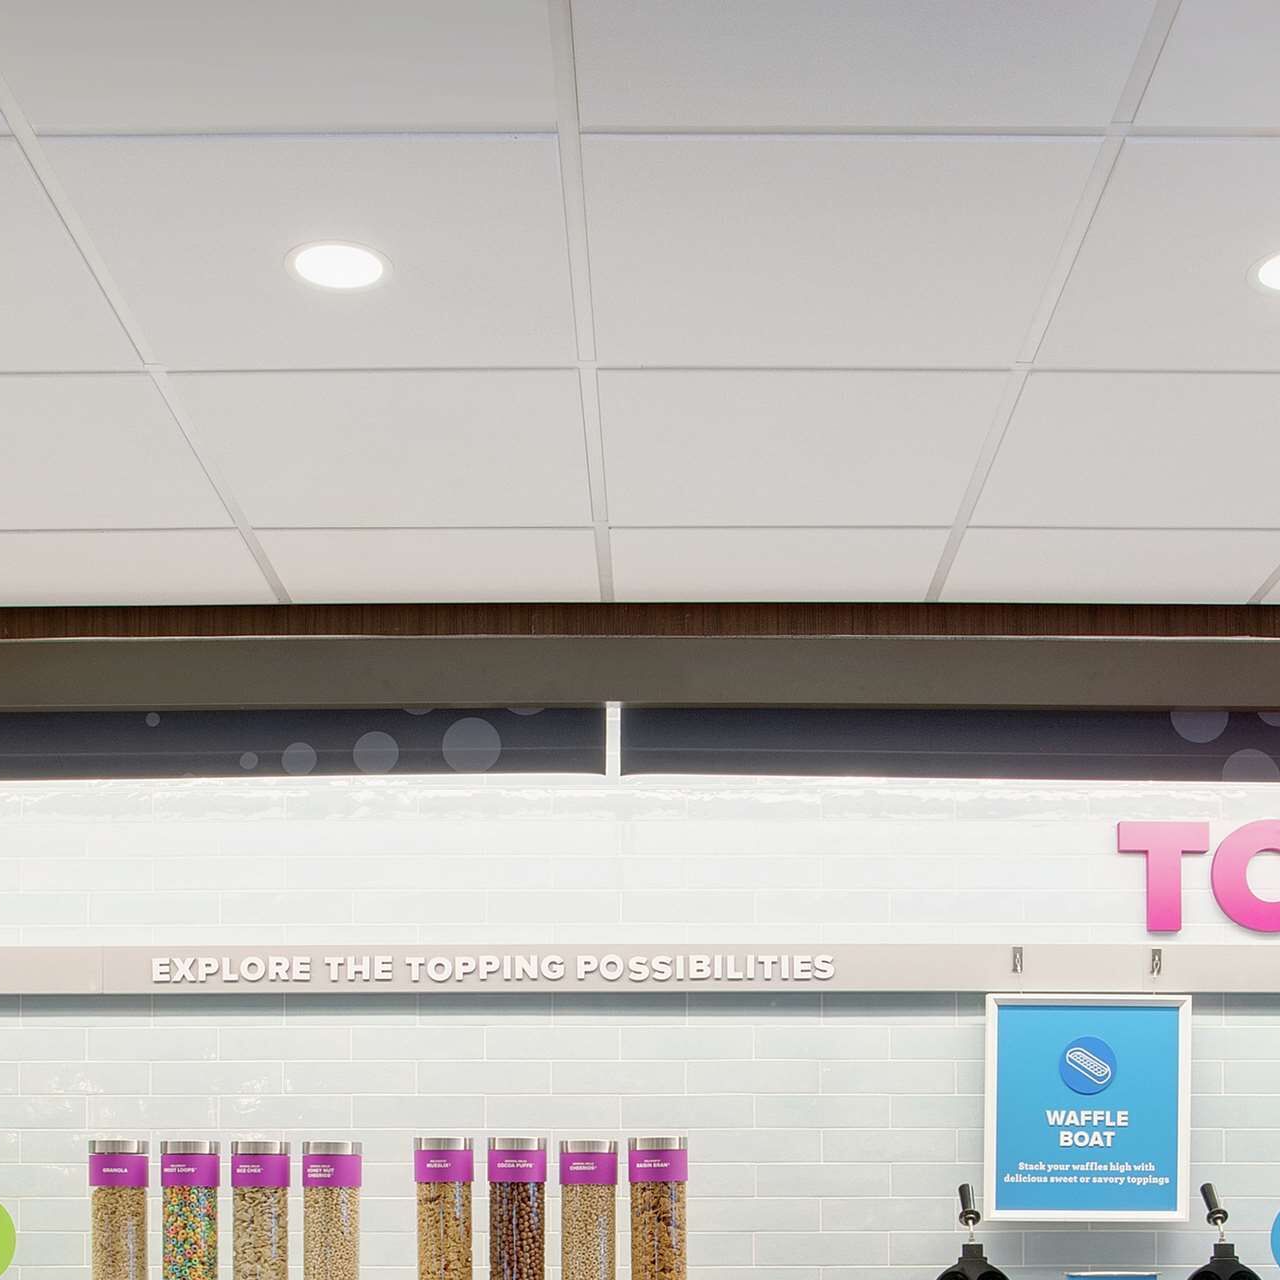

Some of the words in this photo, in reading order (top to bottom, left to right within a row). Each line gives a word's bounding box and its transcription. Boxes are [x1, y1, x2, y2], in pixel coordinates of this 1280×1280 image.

[151, 957, 312, 983] EXPLORE
[325, 956, 394, 982] THE
[405, 955, 565, 983] TOPPING
[576, 954, 836, 982] POSSIBILITIES
[1046, 1110, 1129, 1127] WAFFLE
[1060, 1131, 1116, 1148] BOAT
[1018, 1162, 1047, 1171] Stack
[1047, 1163, 1071, 1173] your
[1072, 1162, 1108, 1171] waffles
[1109, 1162, 1132, 1173] high
[1133, 1162, 1155, 1171] with
[1003, 1174, 1048, 1183] delicious
[1049, 1175, 1077, 1184] sweet
[1092, 1176, 1125, 1185] savory
[1127, 1174, 1169, 1185] toppings
